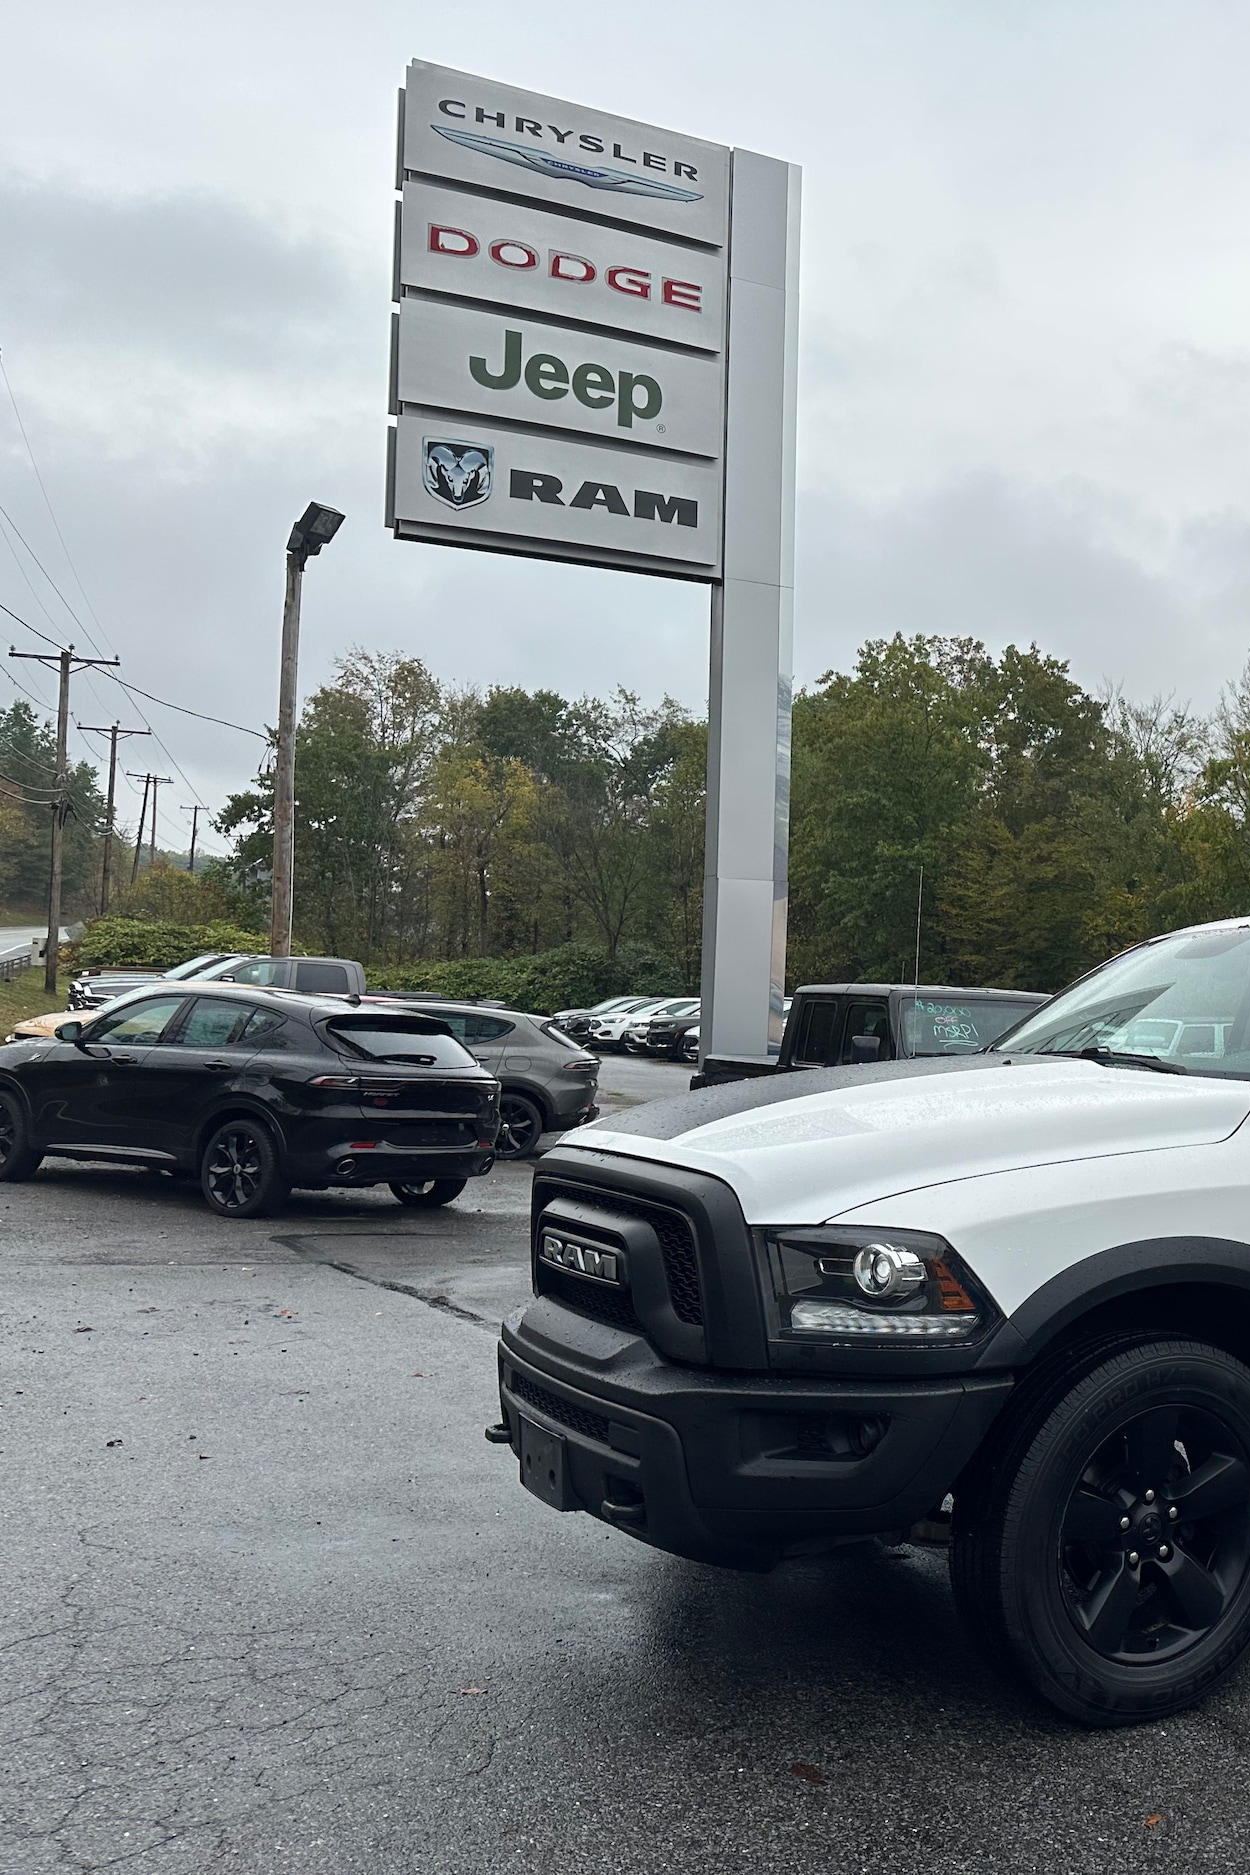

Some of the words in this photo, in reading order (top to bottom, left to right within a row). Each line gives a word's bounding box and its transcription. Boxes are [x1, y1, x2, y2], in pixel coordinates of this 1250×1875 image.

[437, 98, 699, 183] CHRYSLER
[427, 222, 702, 313] DODGE
[469, 329, 663, 428] Jeep
[509, 469, 698, 528] RAM
[543, 1235, 617, 1280] RAM
